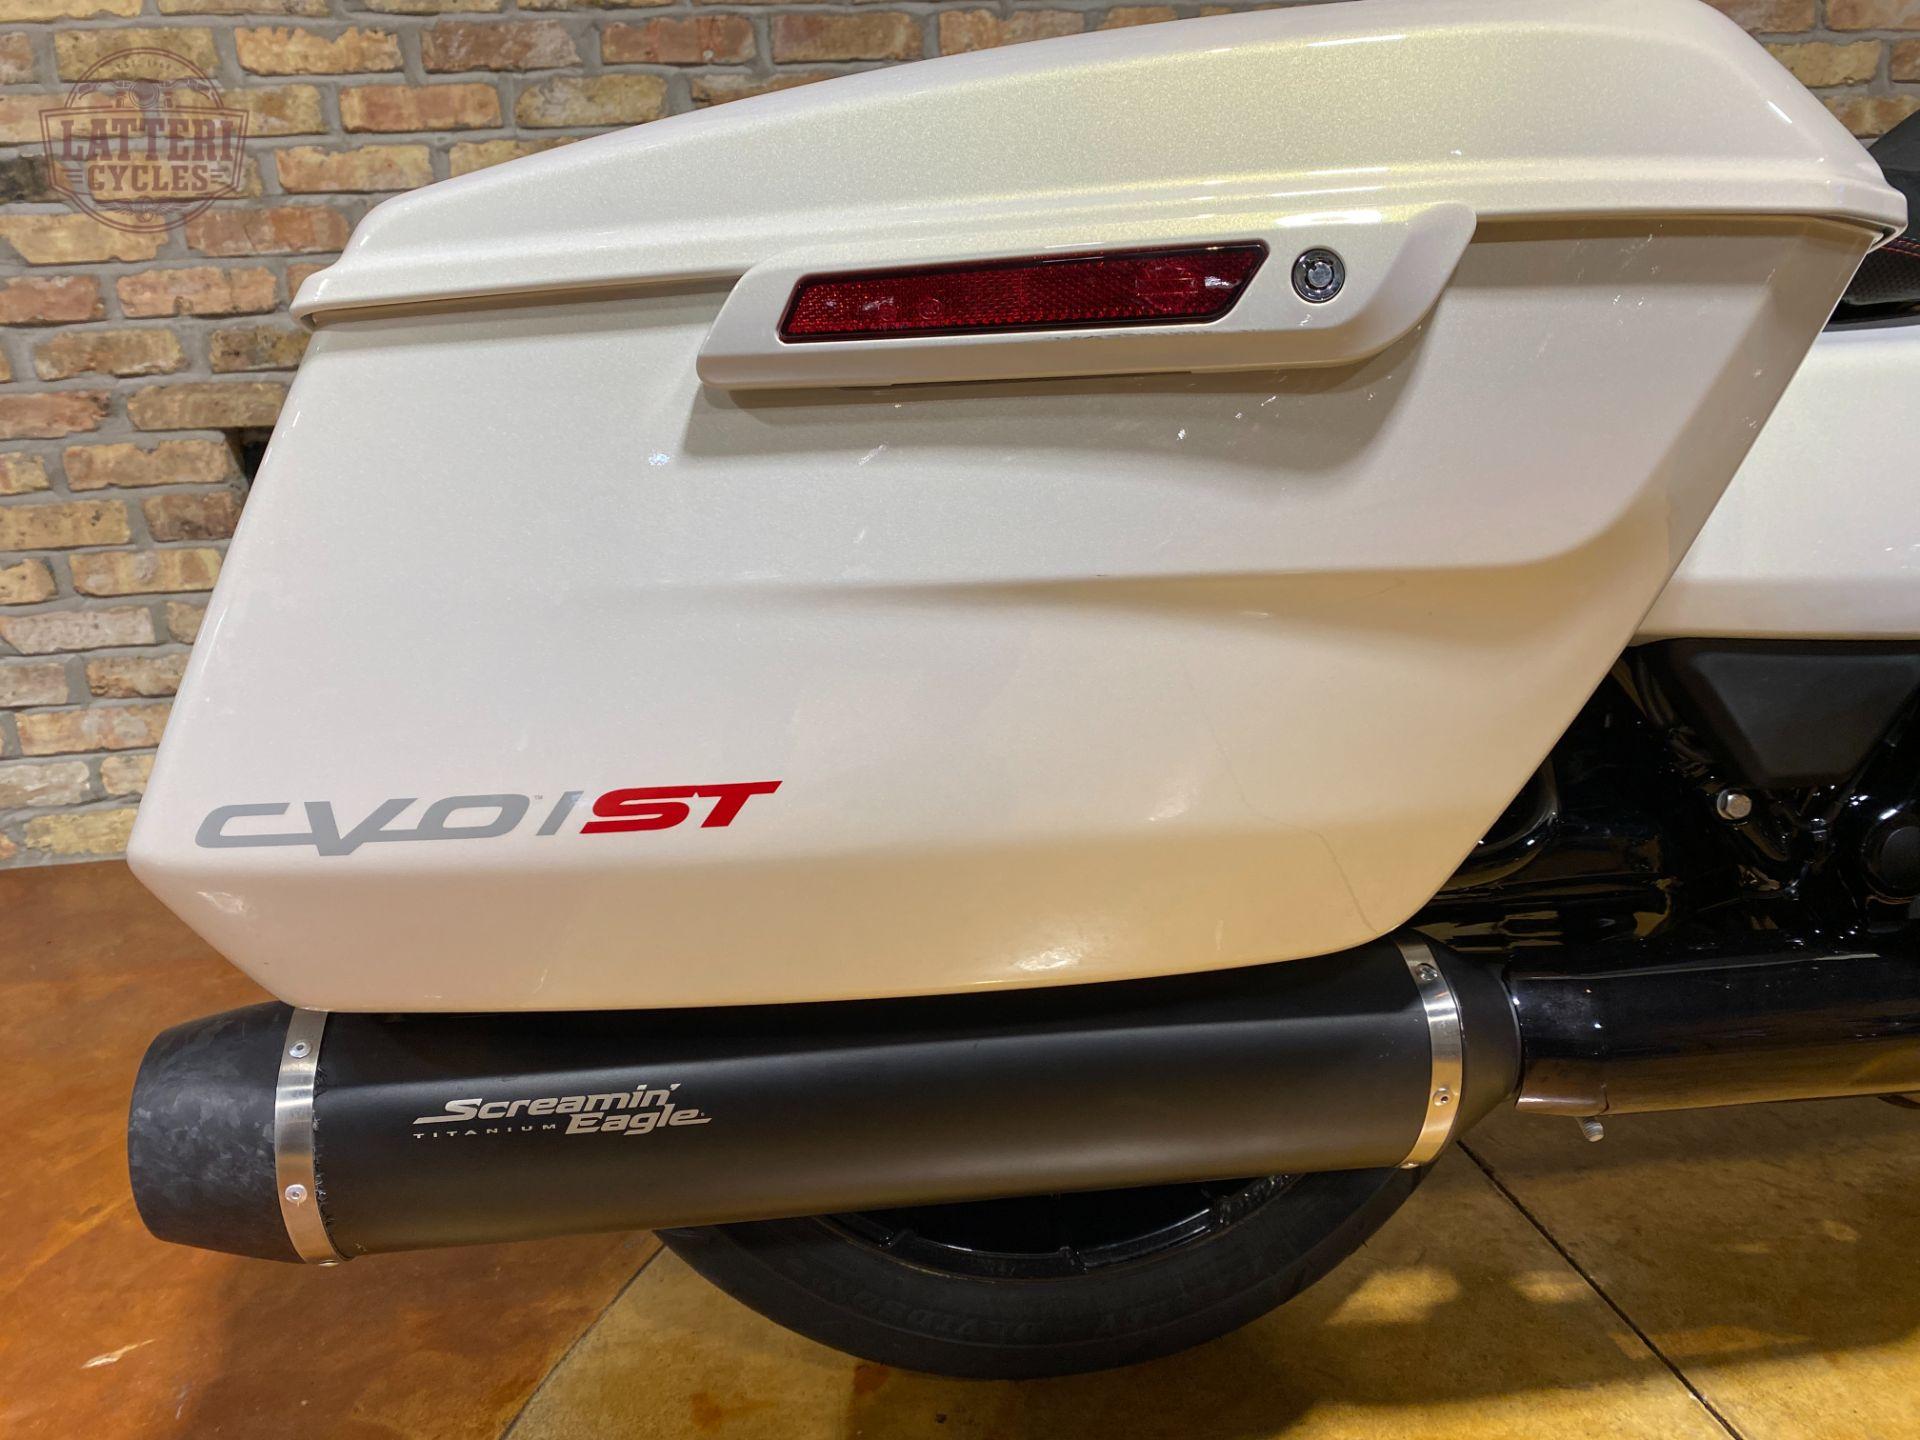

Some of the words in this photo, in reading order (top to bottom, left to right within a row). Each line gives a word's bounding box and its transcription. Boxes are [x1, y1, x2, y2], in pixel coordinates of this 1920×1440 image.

[194, 793, 531, 857] CVO
[579, 780, 784, 834] ST
[412, 1083, 682, 1125] Screamin'
[564, 1103, 713, 1136] Eagle
[413, 1123, 556, 1139] TITANIUM
